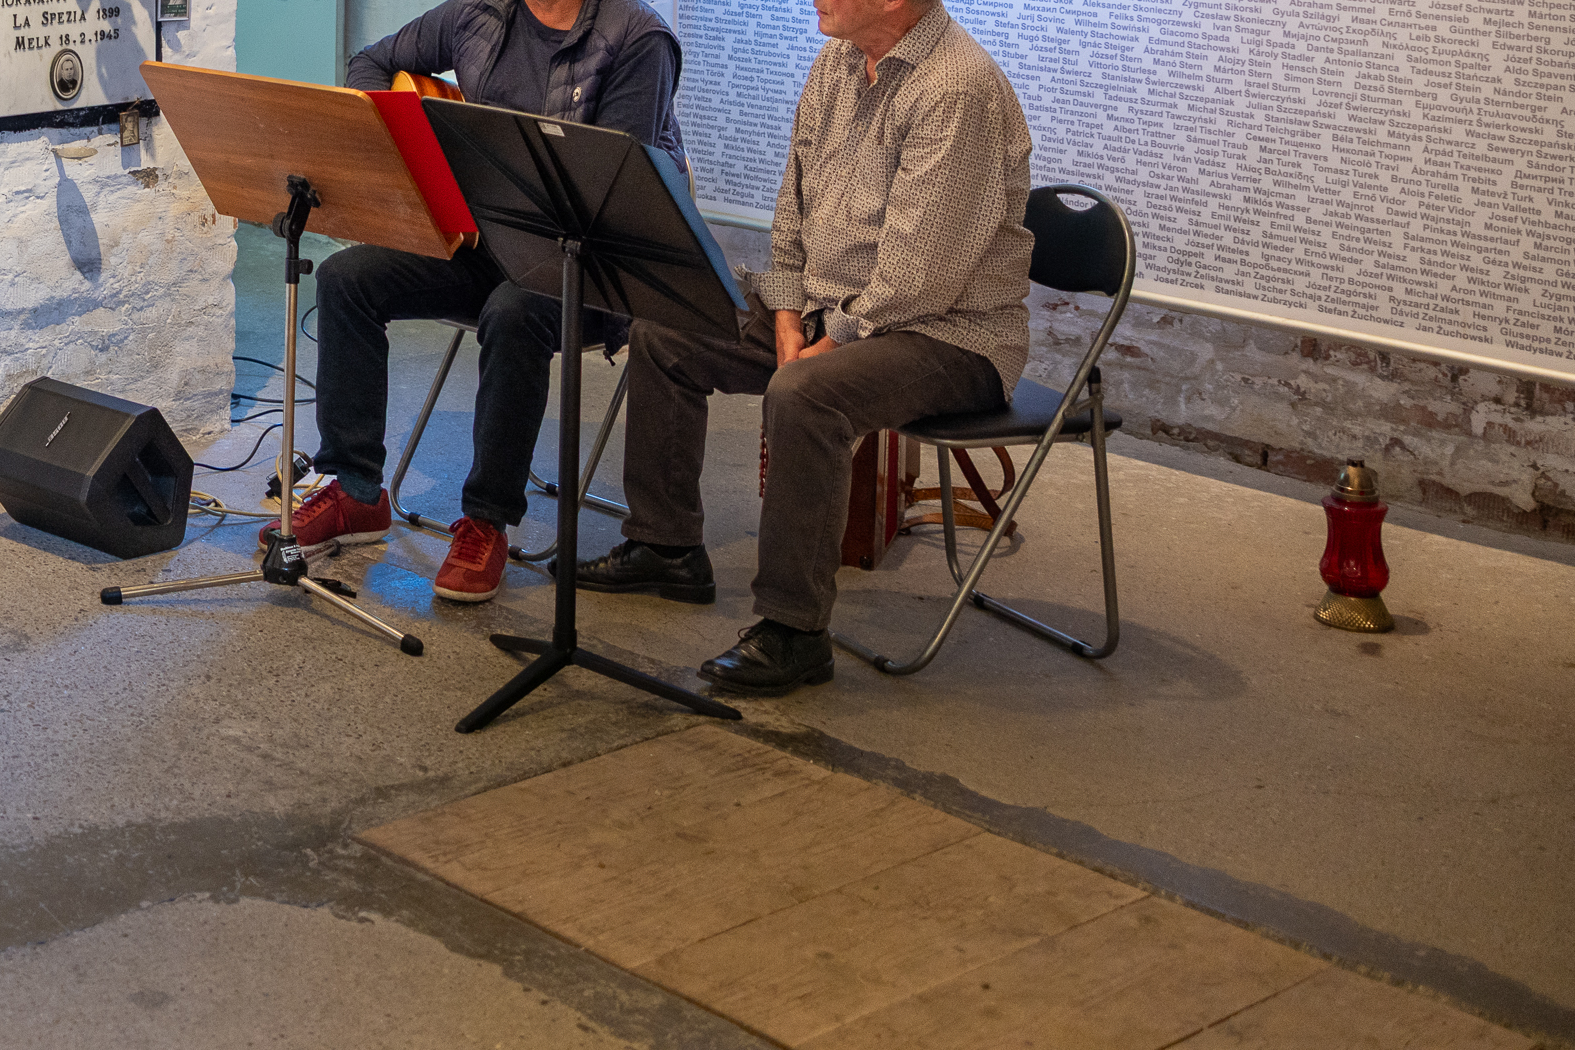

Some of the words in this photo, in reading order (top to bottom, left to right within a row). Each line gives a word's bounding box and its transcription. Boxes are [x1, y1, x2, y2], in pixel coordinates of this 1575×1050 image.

[13, 13, 30, 28] LA
[42, 9, 86, 26] SPEZIA
[97, 7, 120, 20] 1899
[15, 35, 51, 51] MELK
[728, 54, 752, 64] Moszek
[754, 57, 787, 68] Tarnowski
[1142, 241, 1168, 253] Miksa
[1170, 246, 1205, 260] Doppelt
[1214, 255, 1238, 265] Иван
[1240, 259, 1311, 278] Воробьевский
[1214, 285, 1259, 301] Stanisław
[1261, 294, 1307, 310] Zubrzycki
[1415, 323, 1434, 334] Jan
[1436, 325, 1493, 345] Żuchowski
